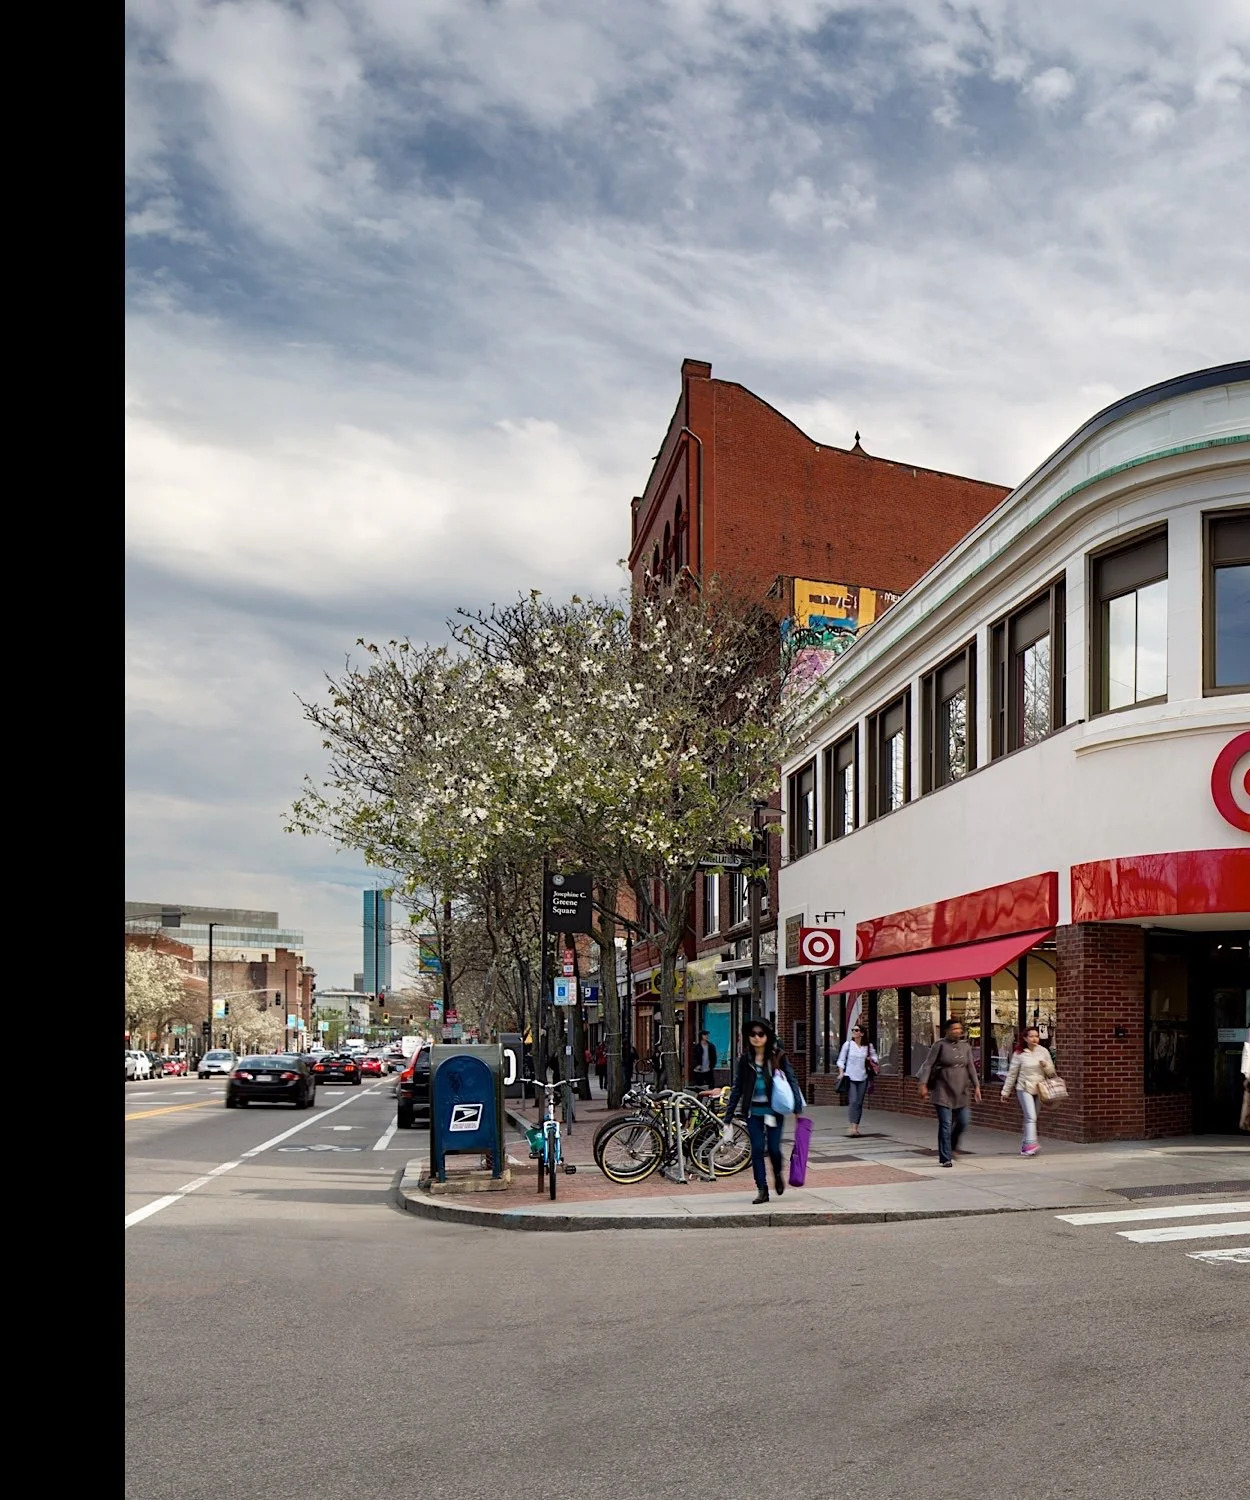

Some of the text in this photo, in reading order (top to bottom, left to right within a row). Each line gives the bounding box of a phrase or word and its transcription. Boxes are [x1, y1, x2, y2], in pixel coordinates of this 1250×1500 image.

[553, 890, 579, 898] Josephine
[553, 898, 578, 906] Greene
[553, 906, 577, 915] Square
